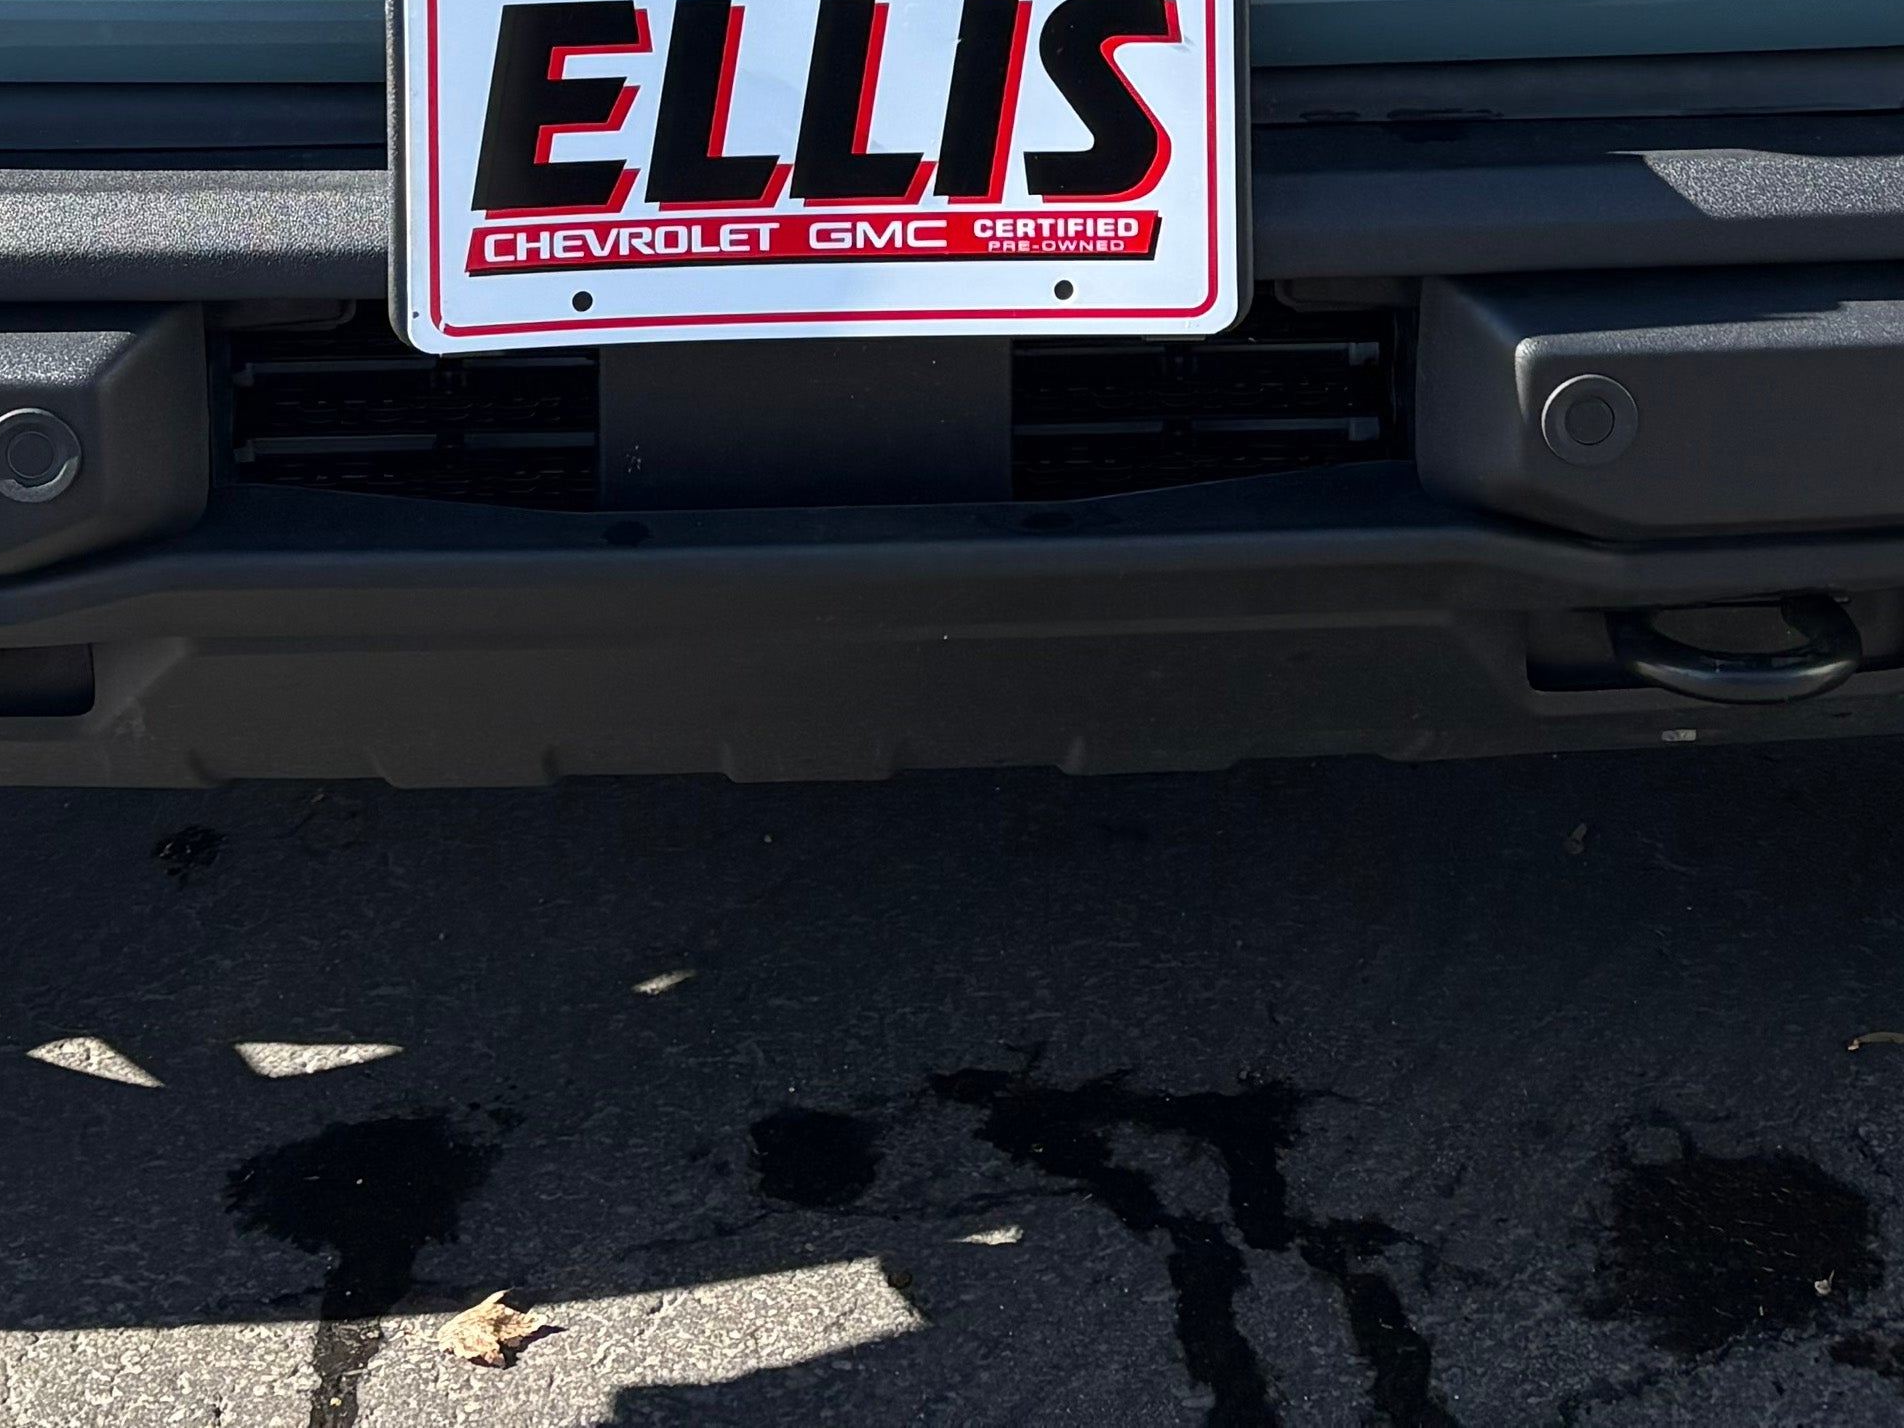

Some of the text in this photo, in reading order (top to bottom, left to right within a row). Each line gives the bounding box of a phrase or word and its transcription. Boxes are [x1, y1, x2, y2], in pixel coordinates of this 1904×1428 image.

[485, 217, 1139, 263] CHEVROLET GMC CERTIFIED
[988, 239, 1125, 254] PRE-OWNED
